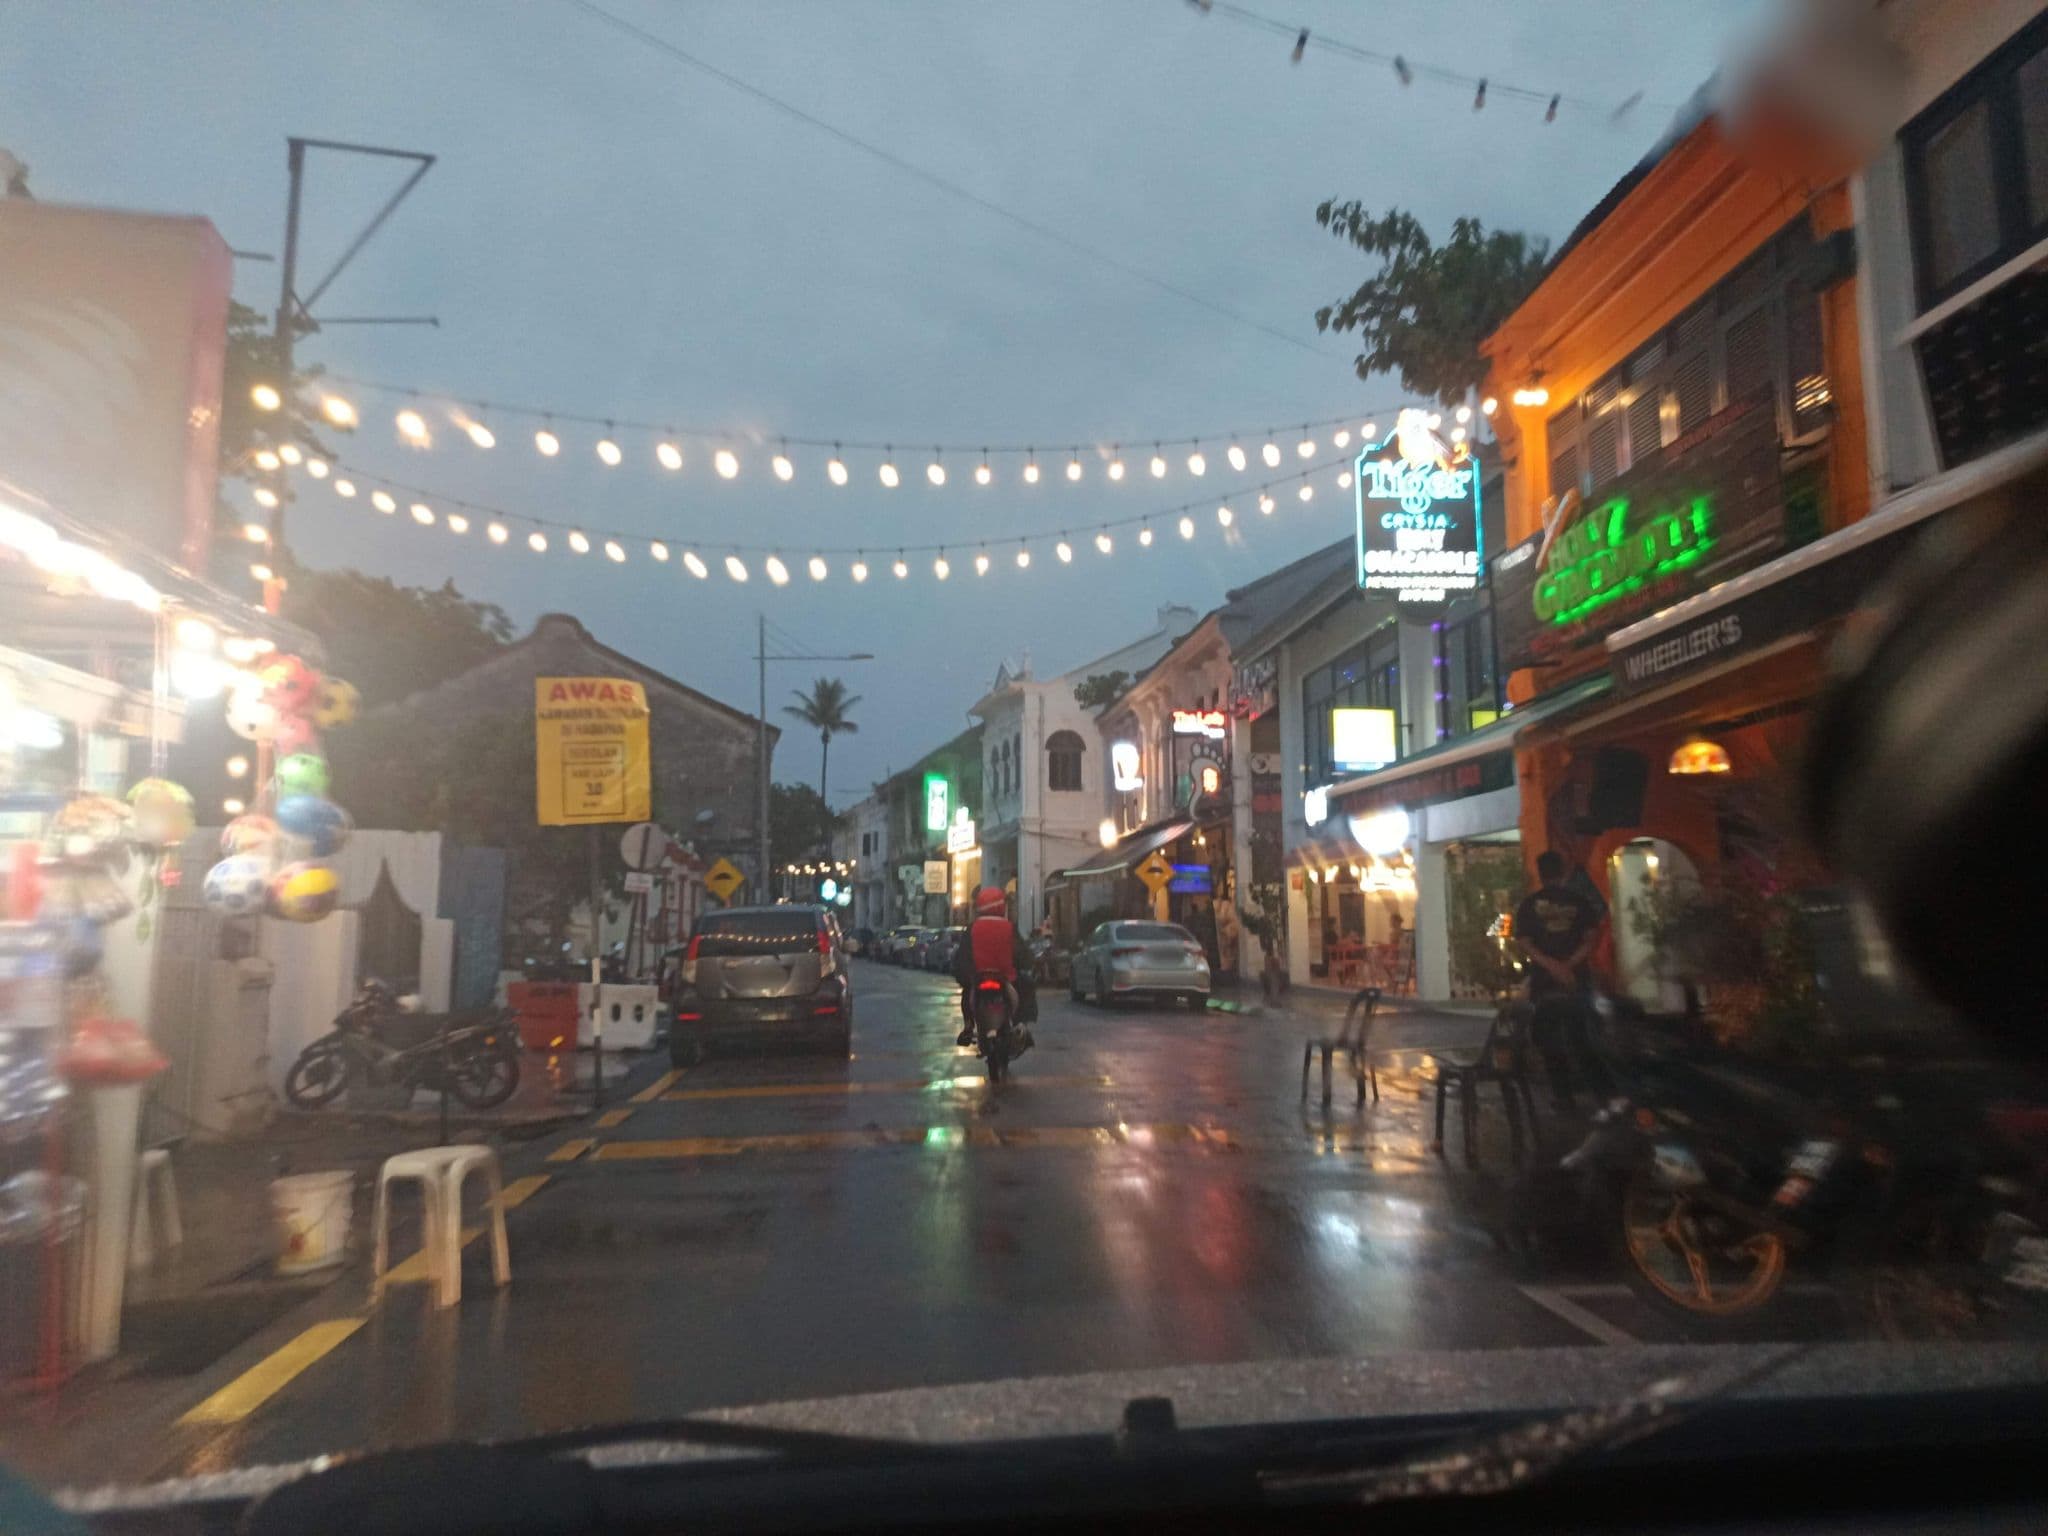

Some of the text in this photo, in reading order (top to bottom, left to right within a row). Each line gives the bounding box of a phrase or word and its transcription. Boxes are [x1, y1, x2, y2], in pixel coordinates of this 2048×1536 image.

[1362, 461, 1473, 514] Tiger
[1624, 614, 1742, 681] WHEELER'S
[550, 683, 635, 701] AWAS
